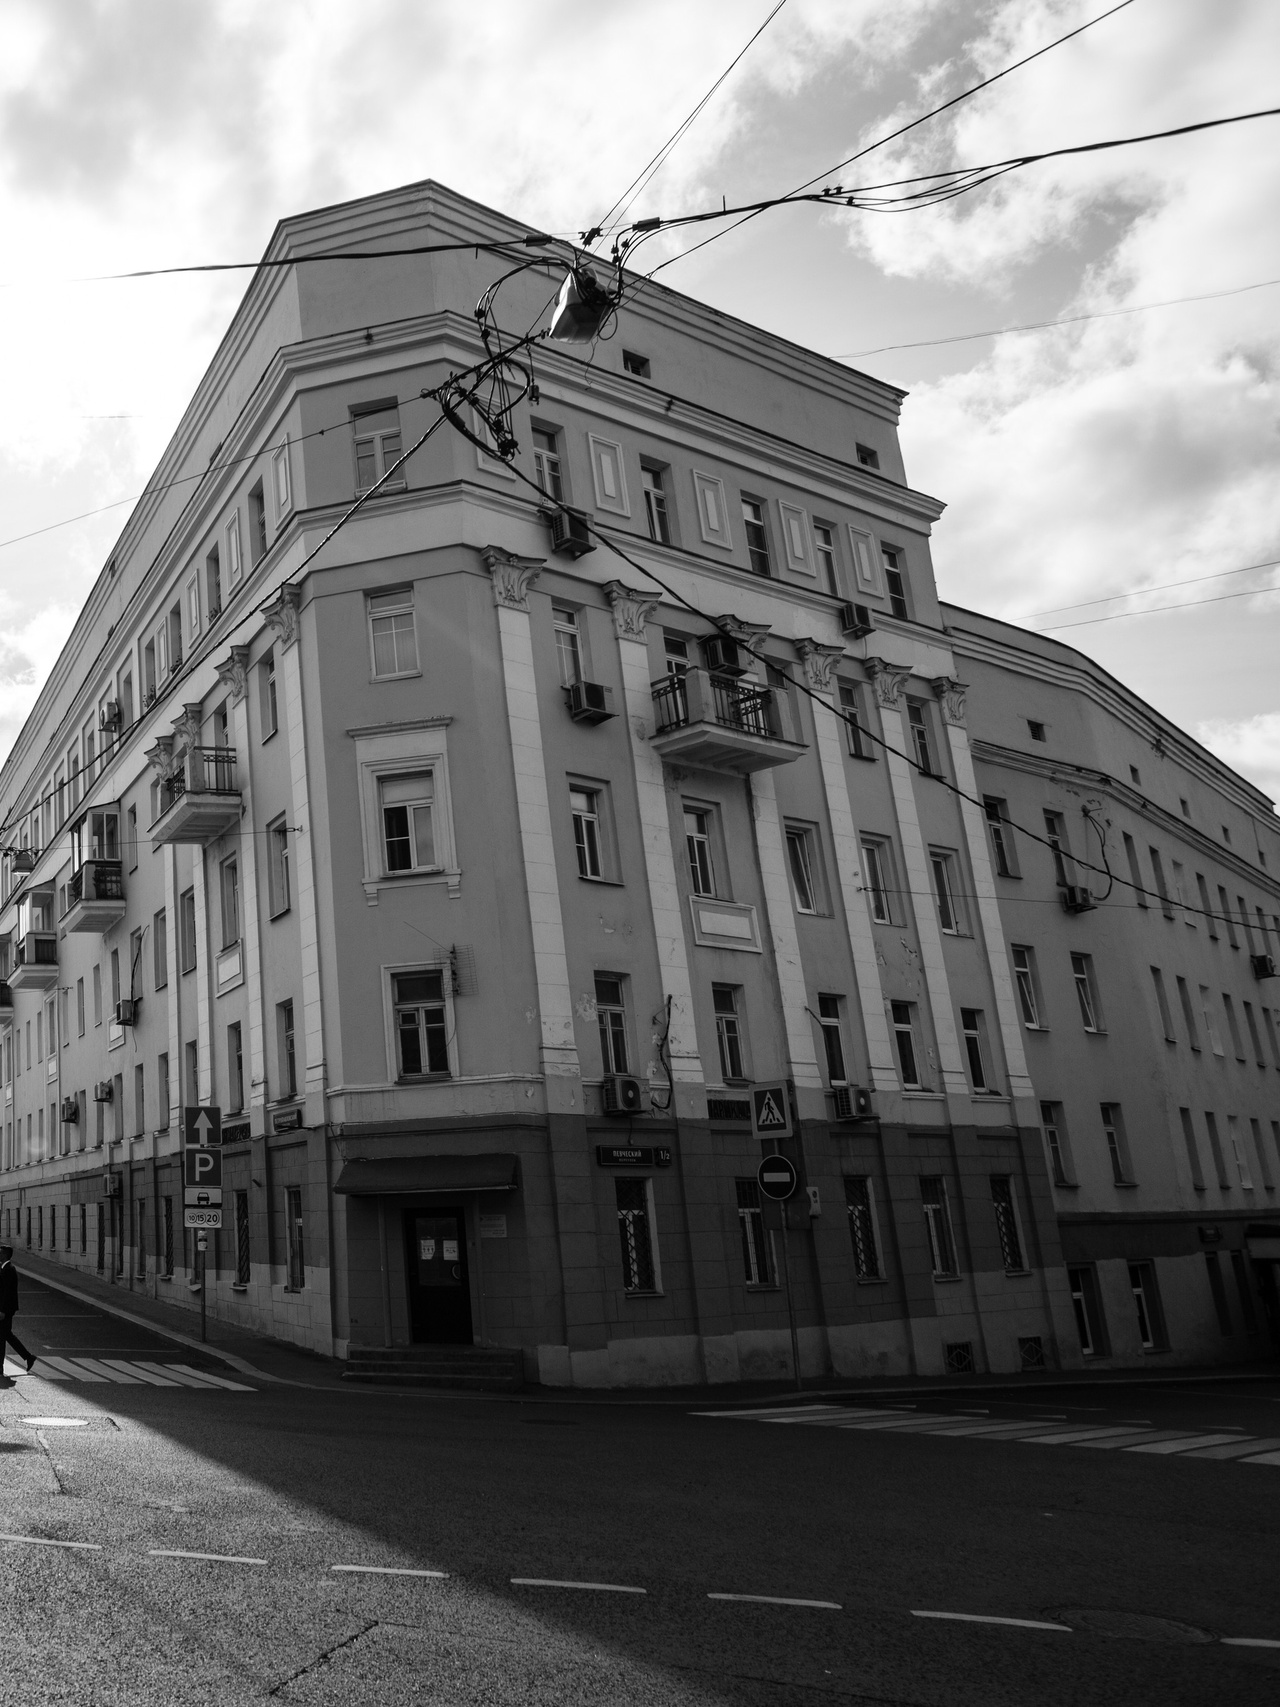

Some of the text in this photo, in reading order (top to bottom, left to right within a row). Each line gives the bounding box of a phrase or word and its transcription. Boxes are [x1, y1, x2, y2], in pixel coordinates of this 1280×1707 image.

[612, 1150, 642, 1158] ПЕВЧЕСКИЙ
[660, 1150, 670, 1161] 1/2
[195, 1153, 214, 1182] P
[197, 1214, 204, 1222] 15
[207, 1214, 218, 1222] 20
